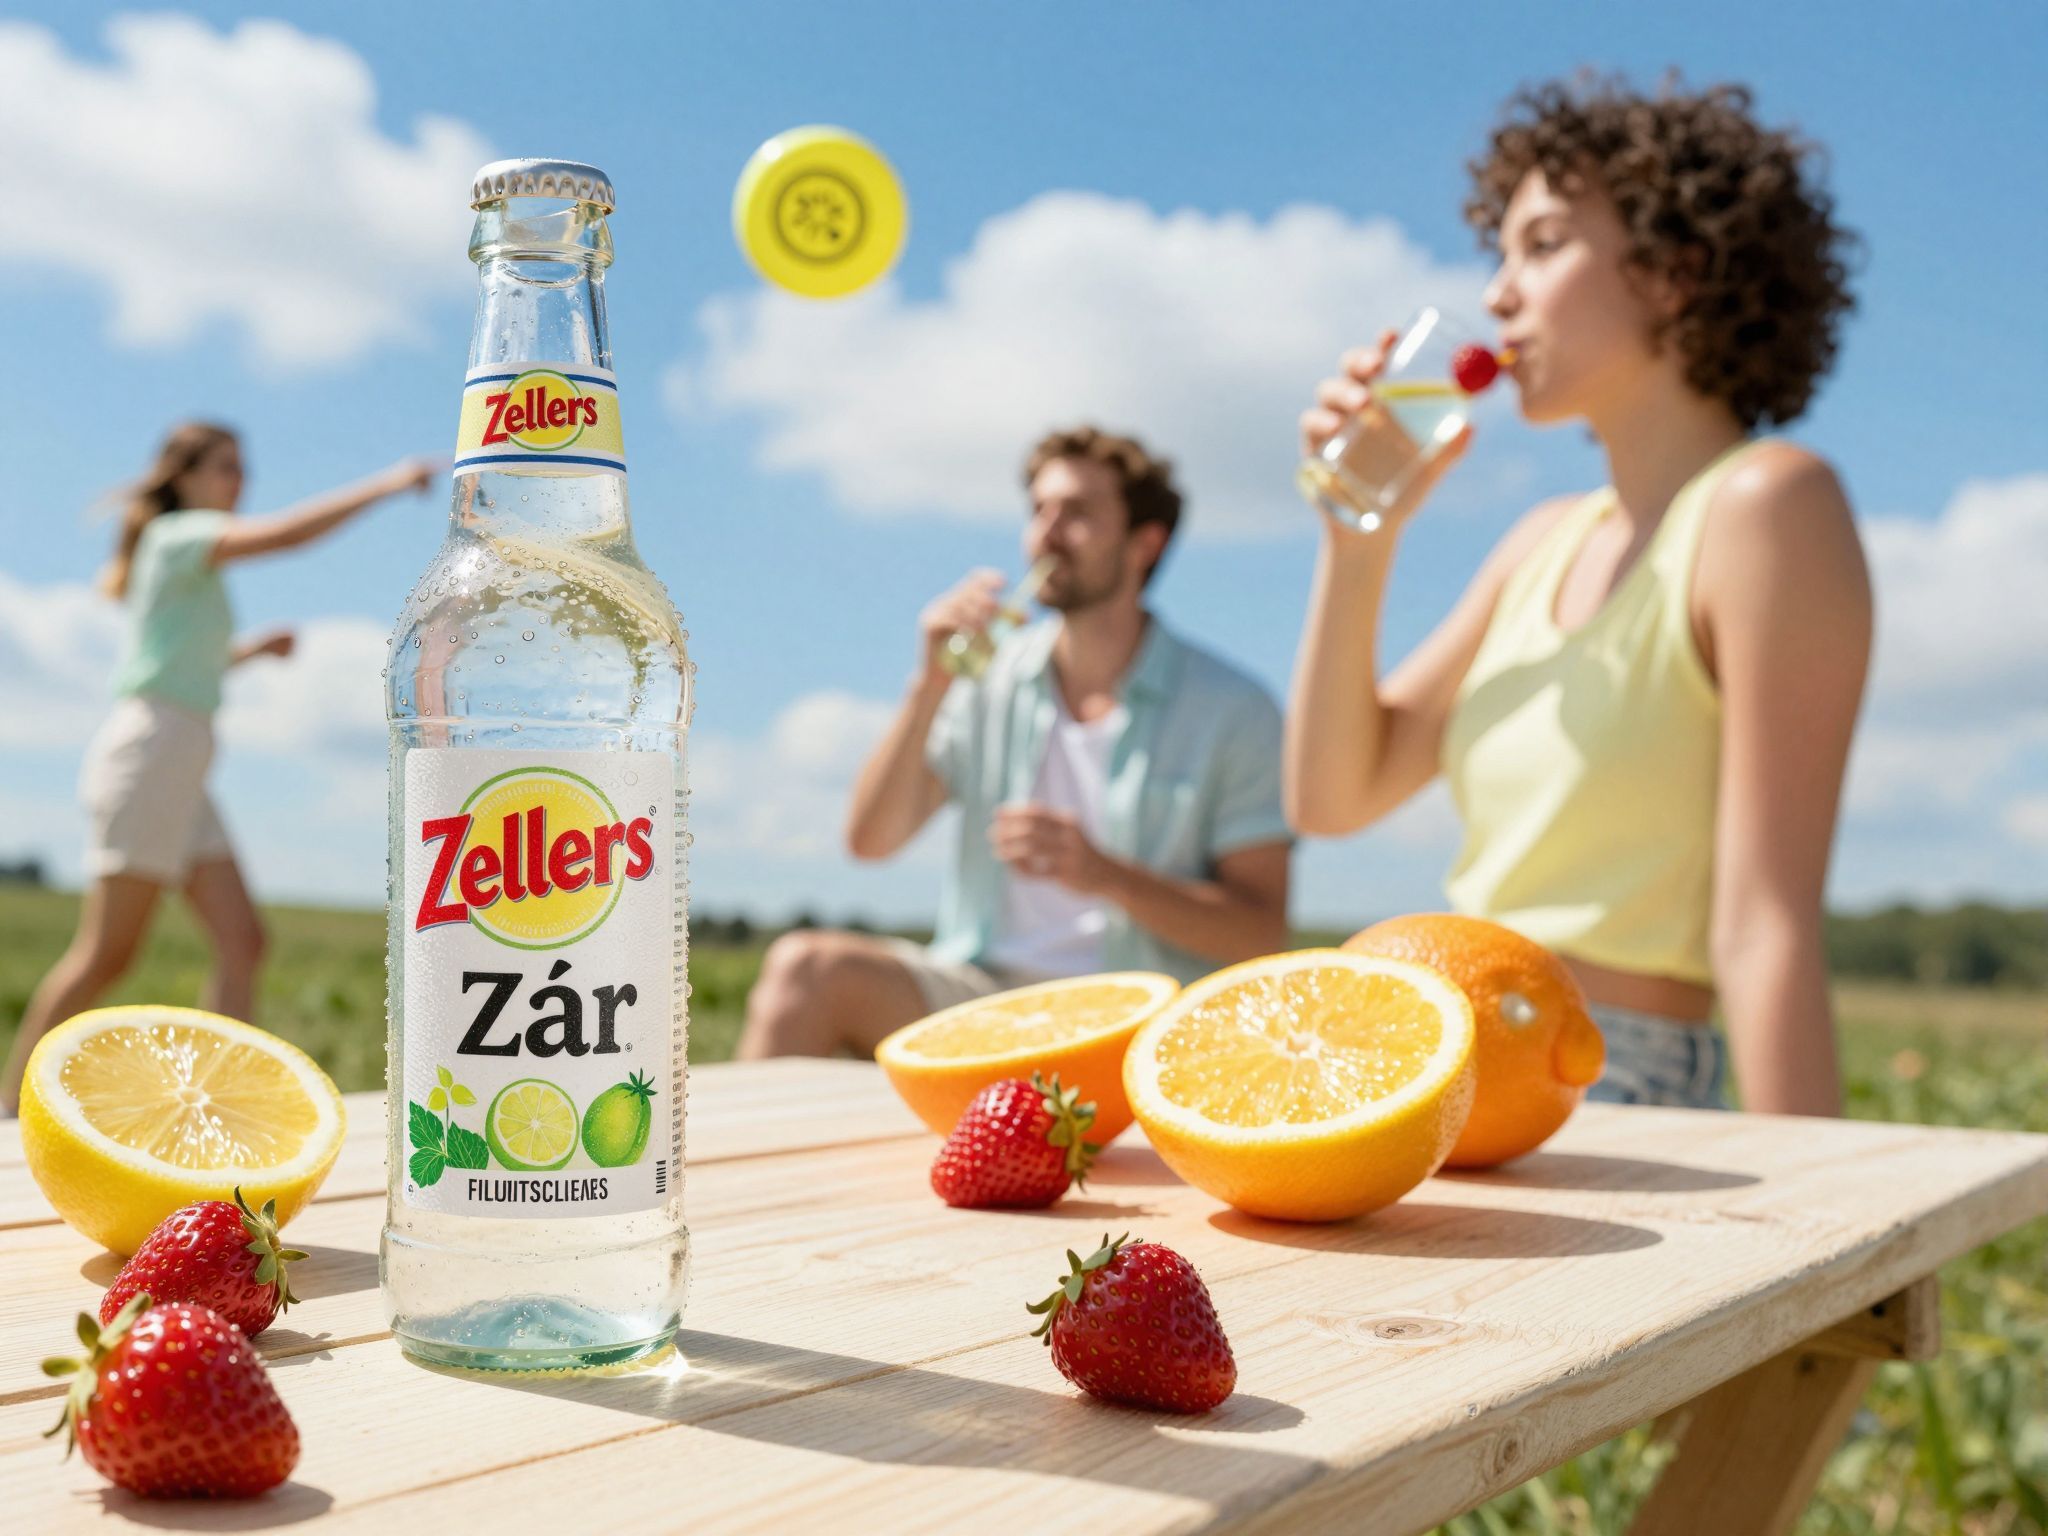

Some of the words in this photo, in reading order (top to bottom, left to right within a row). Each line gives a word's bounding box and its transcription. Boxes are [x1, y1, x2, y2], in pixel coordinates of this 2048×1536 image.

[482, 386, 598, 447] Zellers
[415, 806, 655, 932] Zellers
[457, 959, 638, 1058] Zár
